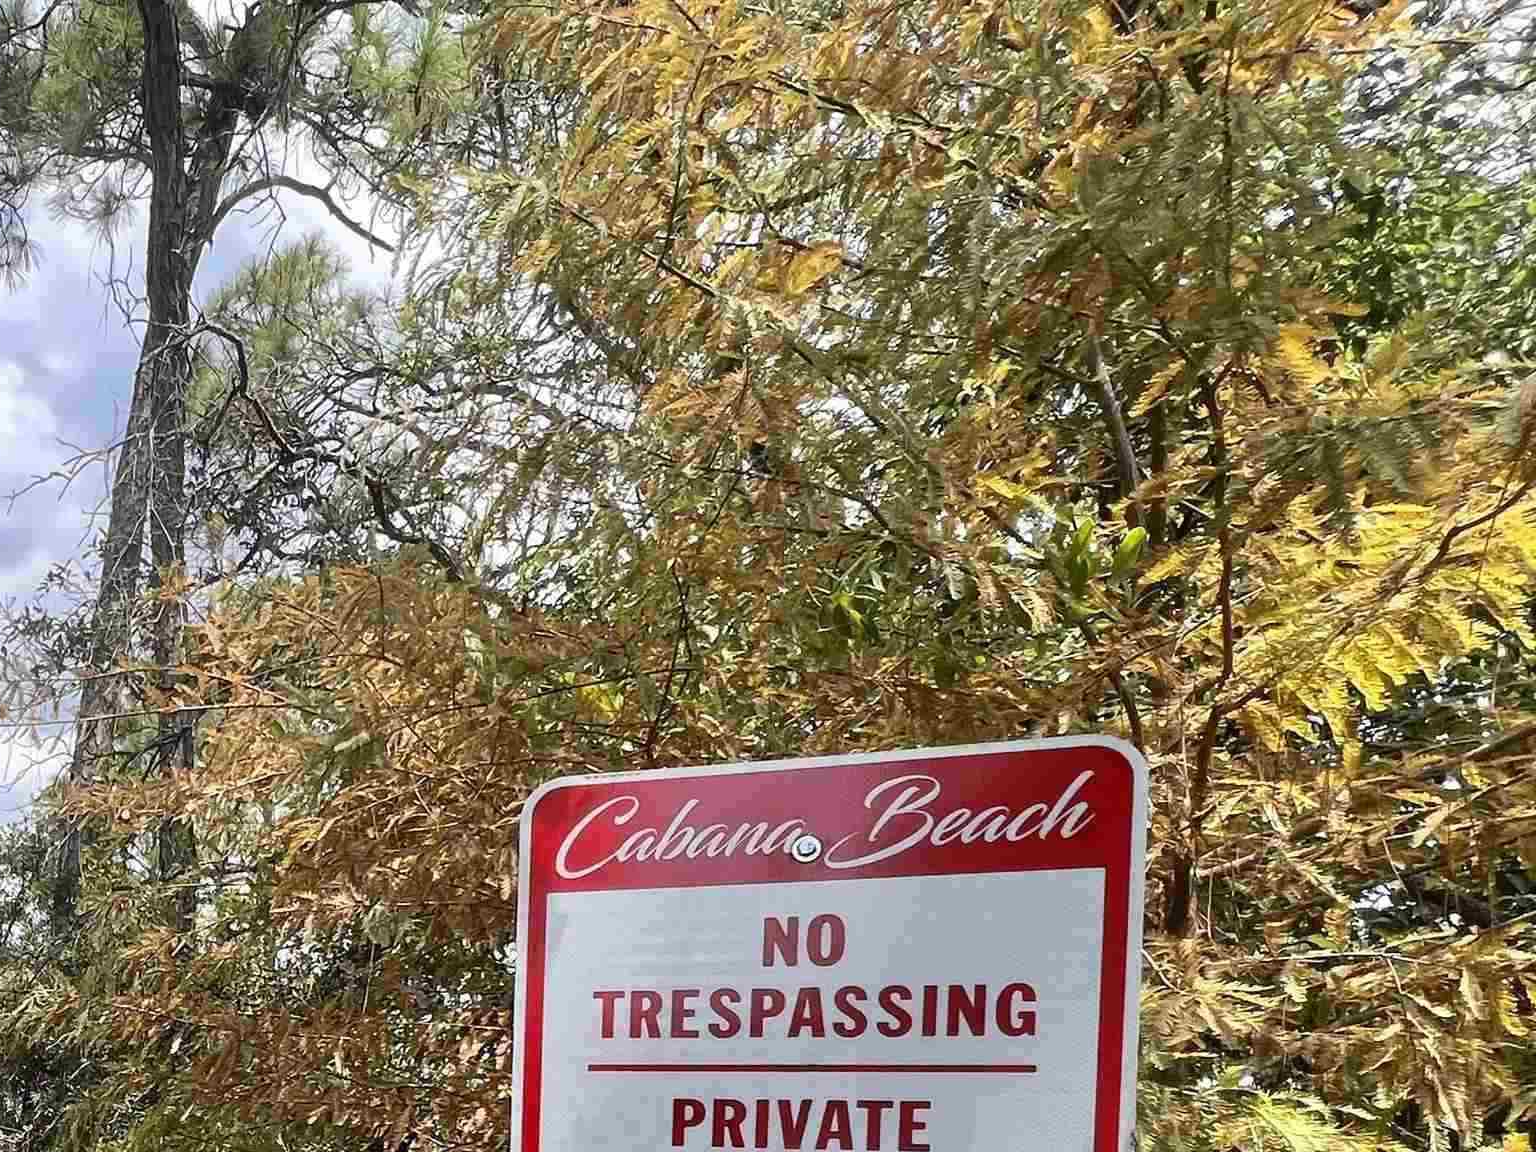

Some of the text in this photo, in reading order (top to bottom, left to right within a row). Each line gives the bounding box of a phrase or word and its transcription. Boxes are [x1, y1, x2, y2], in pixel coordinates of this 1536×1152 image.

[554, 770, 1097, 880] Cabana Beach
[761, 913, 846, 967] NO
[593, 982, 1038, 1040] TRESPASSING
[671, 1098, 931, 1152] PRIVATE
